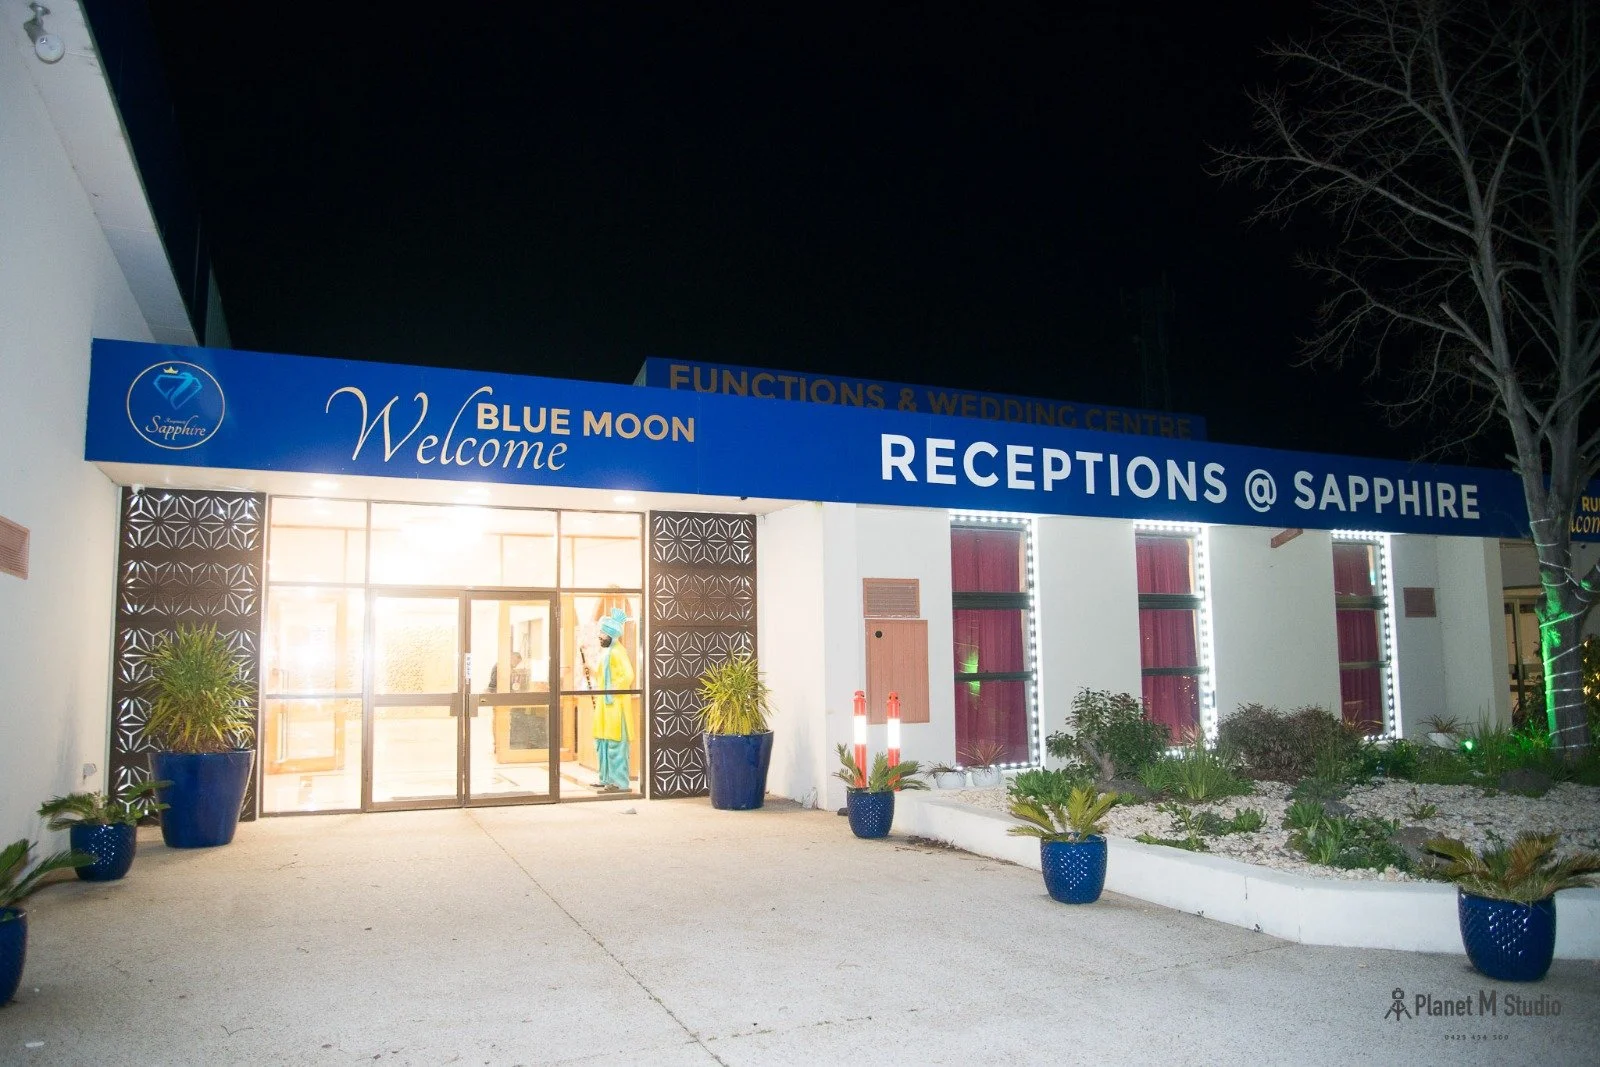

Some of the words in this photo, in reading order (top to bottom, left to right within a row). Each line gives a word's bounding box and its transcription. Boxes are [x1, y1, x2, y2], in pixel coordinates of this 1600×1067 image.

[145, 415, 206, 440] Sapphire
[325, 386, 568, 471] Welcome
[477, 403, 571, 436] BLUE
[583, 410, 695, 443] MOON
[670, 364, 886, 409] FUNCTIONS
[897, 388, 918, 412] &
[928, 390, 1077, 427] WEDDING
[1086, 409, 1192, 440] CENTRE
[881, 433, 1228, 504] RECEPTIONS
[1244, 468, 1278, 513] @
[1293, 470, 1481, 520] SAPPHIRE
